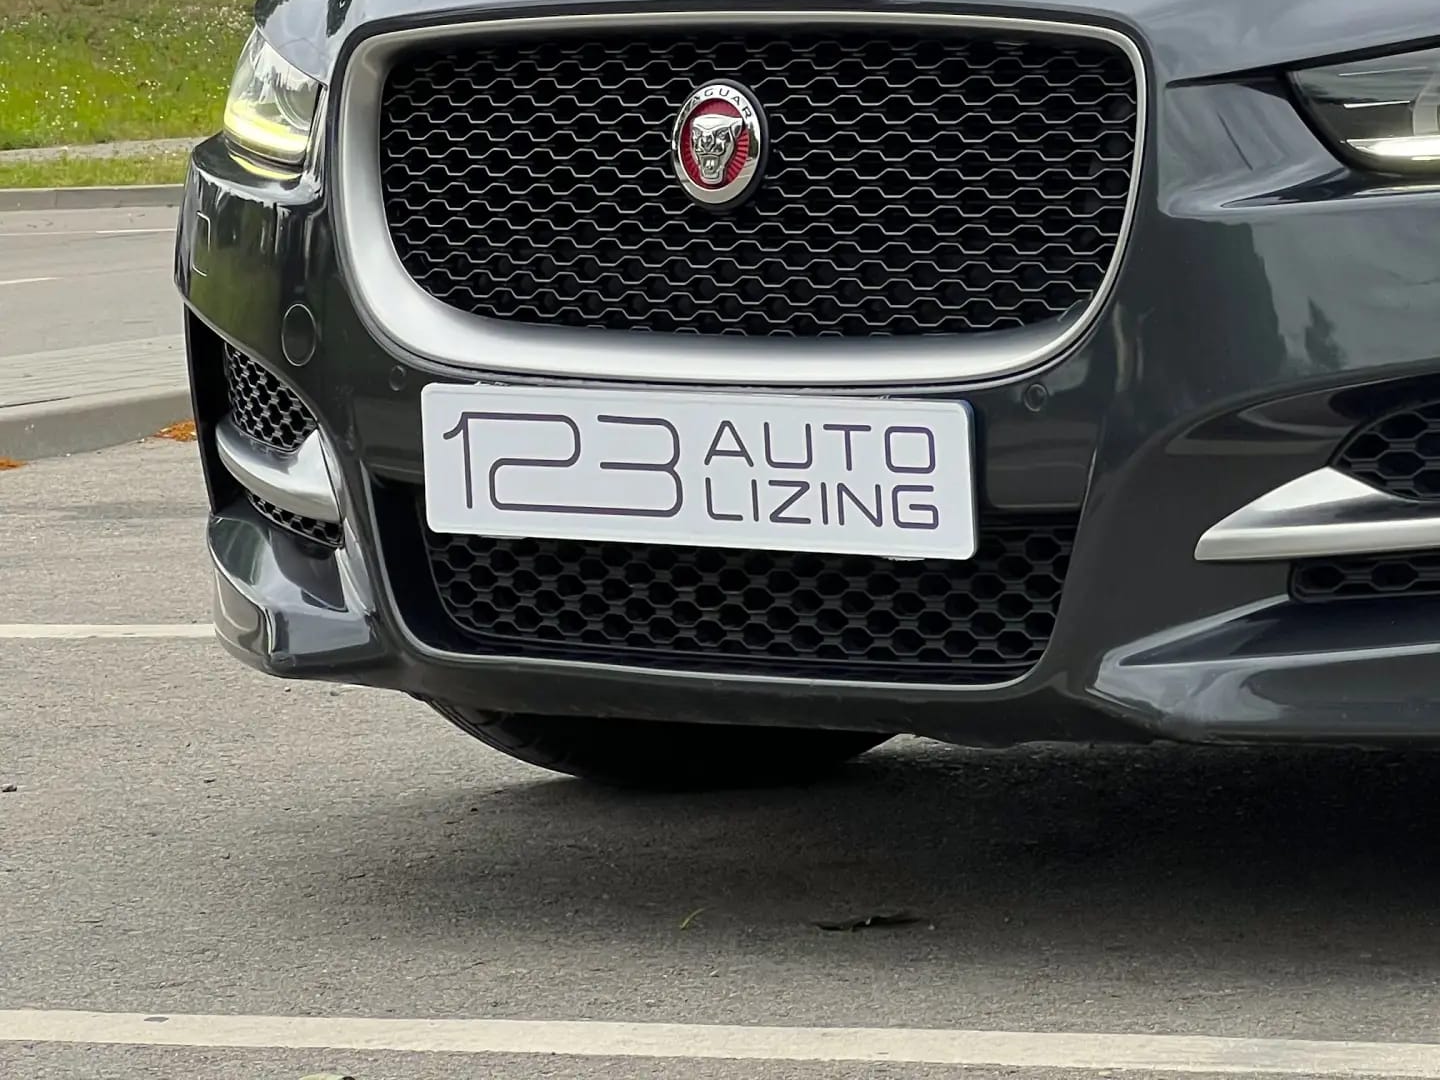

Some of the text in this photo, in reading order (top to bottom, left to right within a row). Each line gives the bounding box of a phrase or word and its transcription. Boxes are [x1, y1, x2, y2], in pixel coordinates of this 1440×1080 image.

[443, 410, 684, 518] 123
[704, 420, 936, 474] AUTO
[705, 476, 940, 530] LIZING
